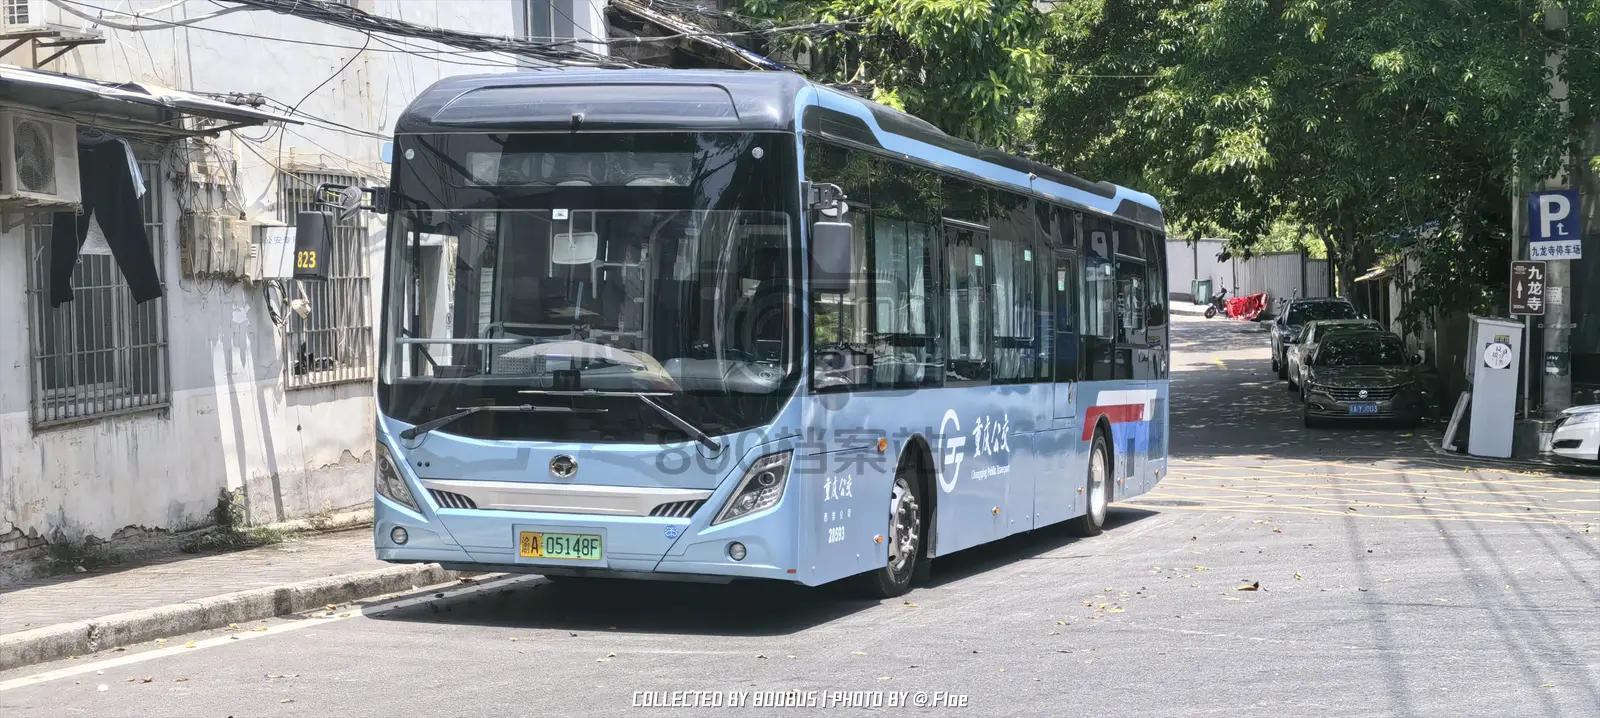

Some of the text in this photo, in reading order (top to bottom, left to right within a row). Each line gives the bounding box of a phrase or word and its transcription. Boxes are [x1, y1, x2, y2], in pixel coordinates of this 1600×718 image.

[1539, 194, 1570, 238] P
[297, 251, 317, 268] 823
[1531, 244, 1580, 257] 九龙寺停车场
[1527, 265, 1543, 311] 九龙寺
[828, 526, 845, 544] 28593
